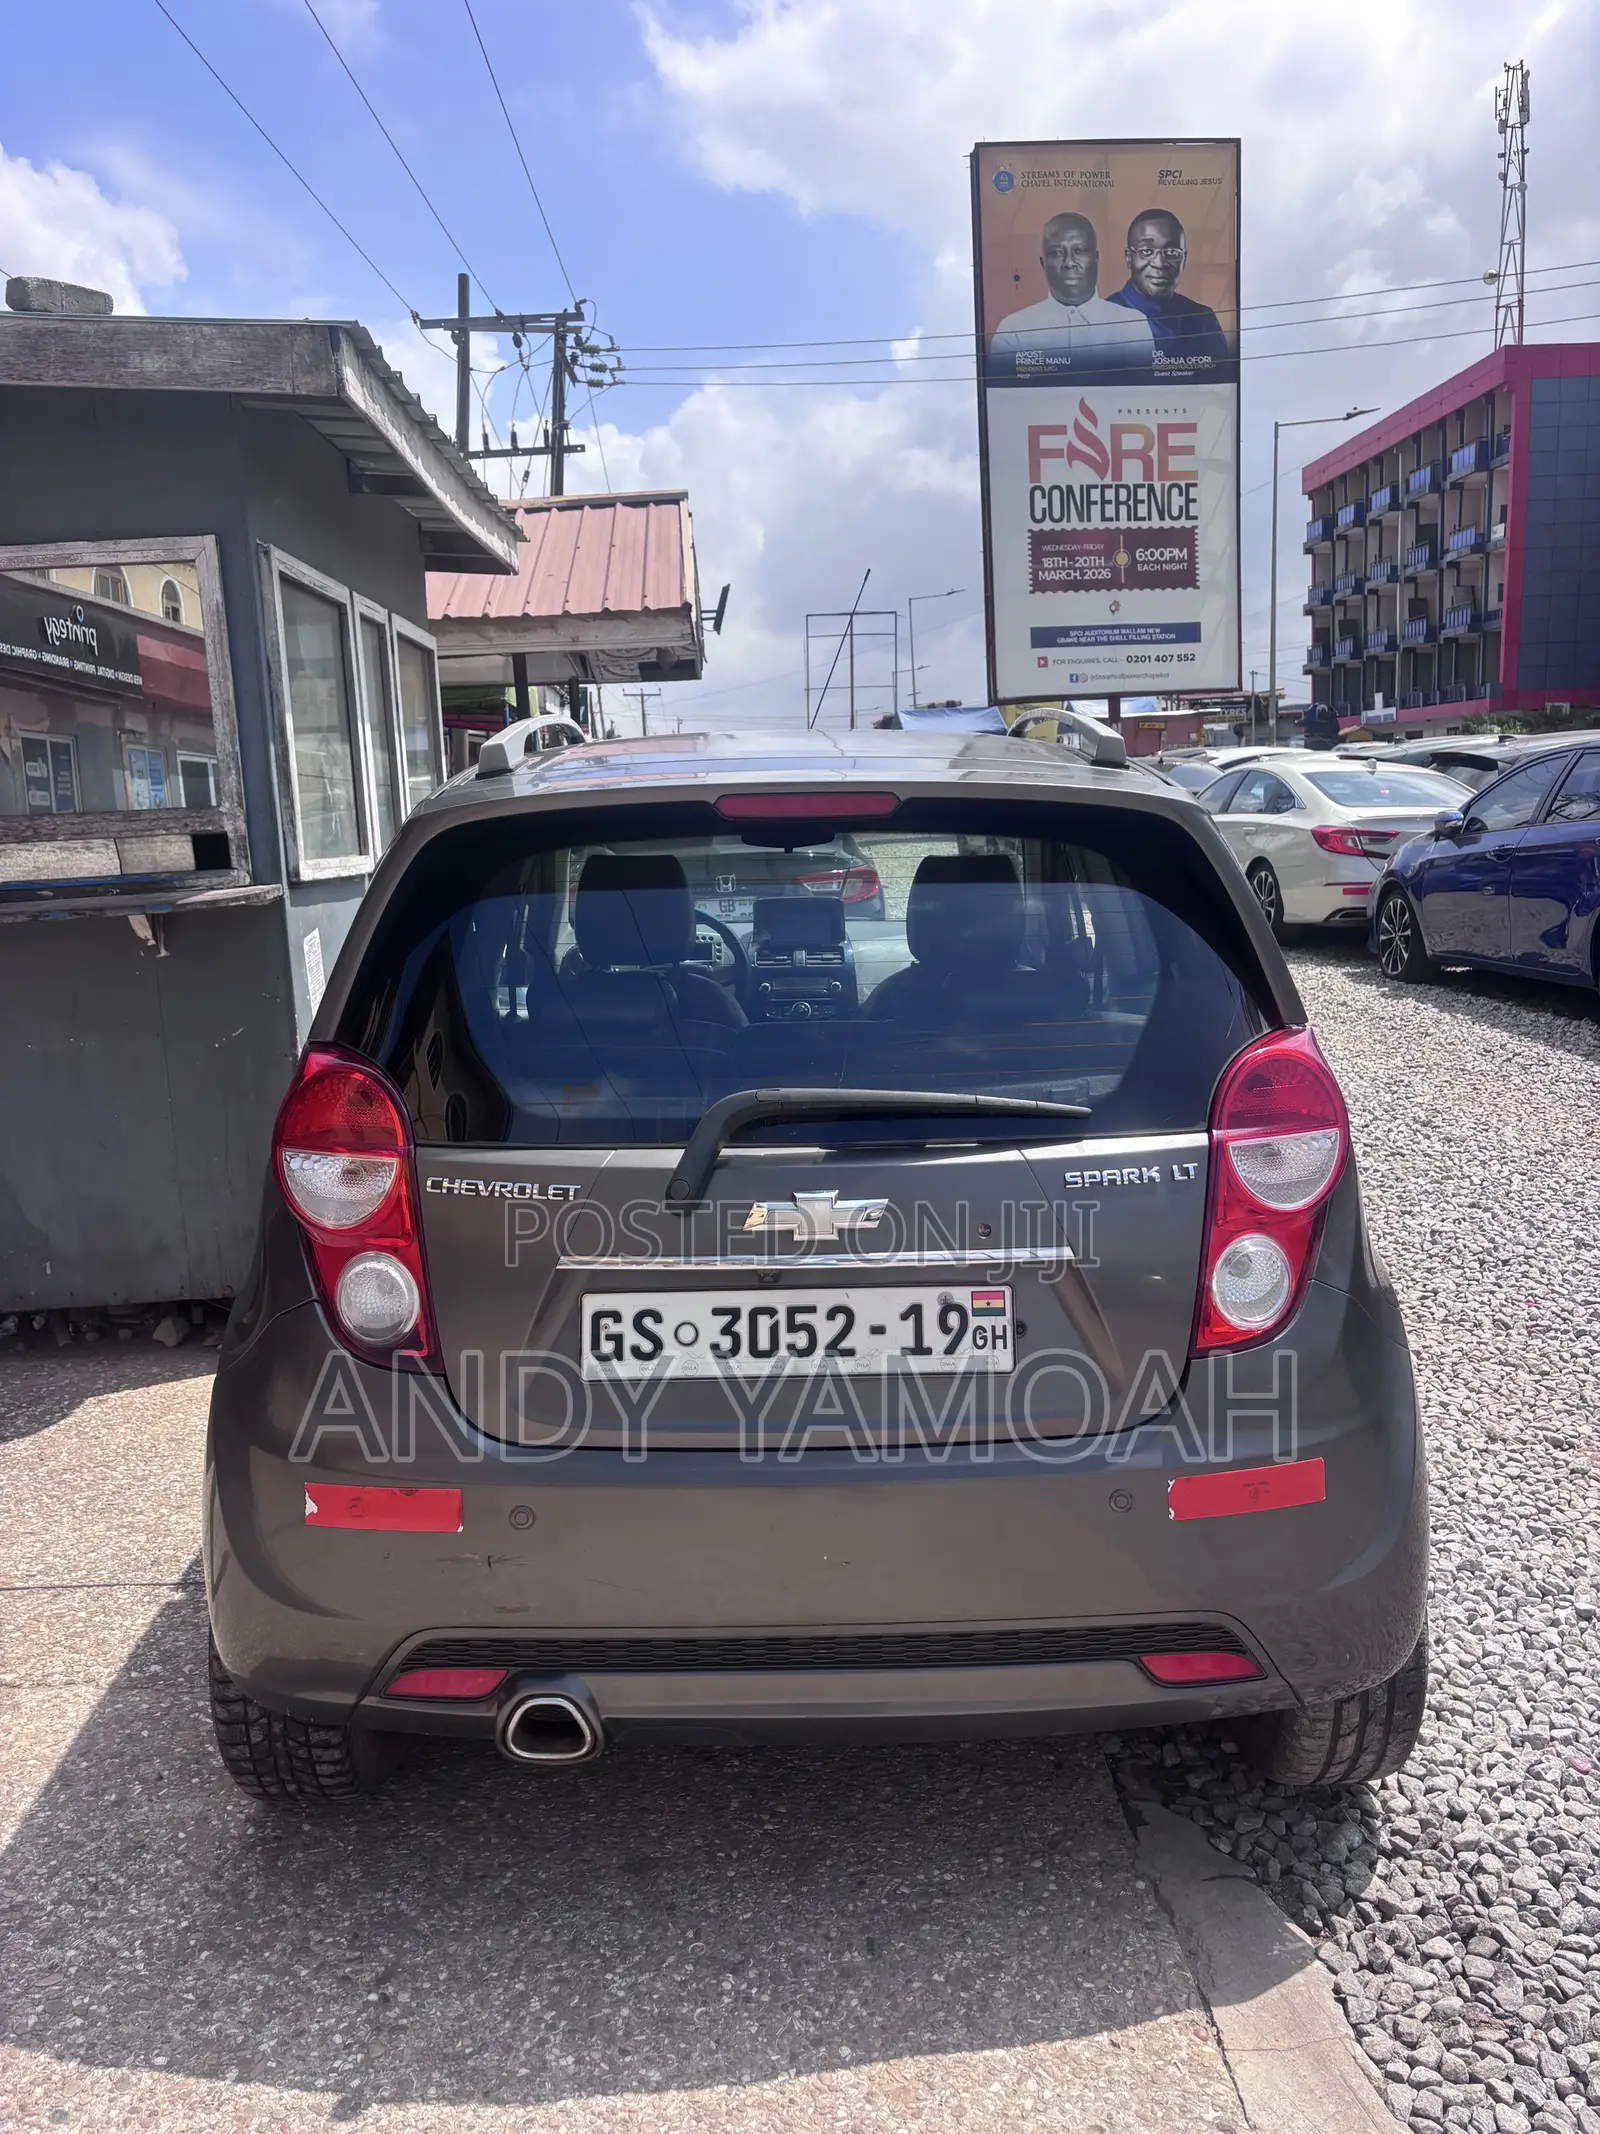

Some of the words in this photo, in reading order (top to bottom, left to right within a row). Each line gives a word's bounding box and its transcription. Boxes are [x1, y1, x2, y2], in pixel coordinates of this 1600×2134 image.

[1021, 171, 1060, 179] STREAMS
[1064, 170, 1076, 179] OF
[1080, 171, 1112, 180] POWER
[1158, 170, 1182, 179] SPCI
[1021, 180, 1052, 188] CHAPEL
[1054, 180, 1116, 188] INTERNATIONAL
[1046, 357, 1071, 365] MANU
[1152, 357, 1185, 365] JOSHUA
[1186, 356, 1212, 364] OFORI
[1029, 483, 1198, 523] CONFERENCE
[1136, 548, 1188, 561] 6:00PM
[1137, 563, 1160, 572] EACH
[1162, 562, 1188, 571] NIGHT
[1083, 569, 1111, 580] 2026
[1126, 655, 1152, 664] 0201
[1154, 654, 1174, 663] 407
[1177, 653, 1196, 662] 552
[720, 900, 736, 913] GB
[1064, 1166, 1161, 1189] SPARK
[1172, 1162, 1198, 1182] LT
[426, 1176, 581, 1201] CHEVROLET
[590, 1306, 664, 1362] GS
[972, 1324, 1008, 1350] GH
